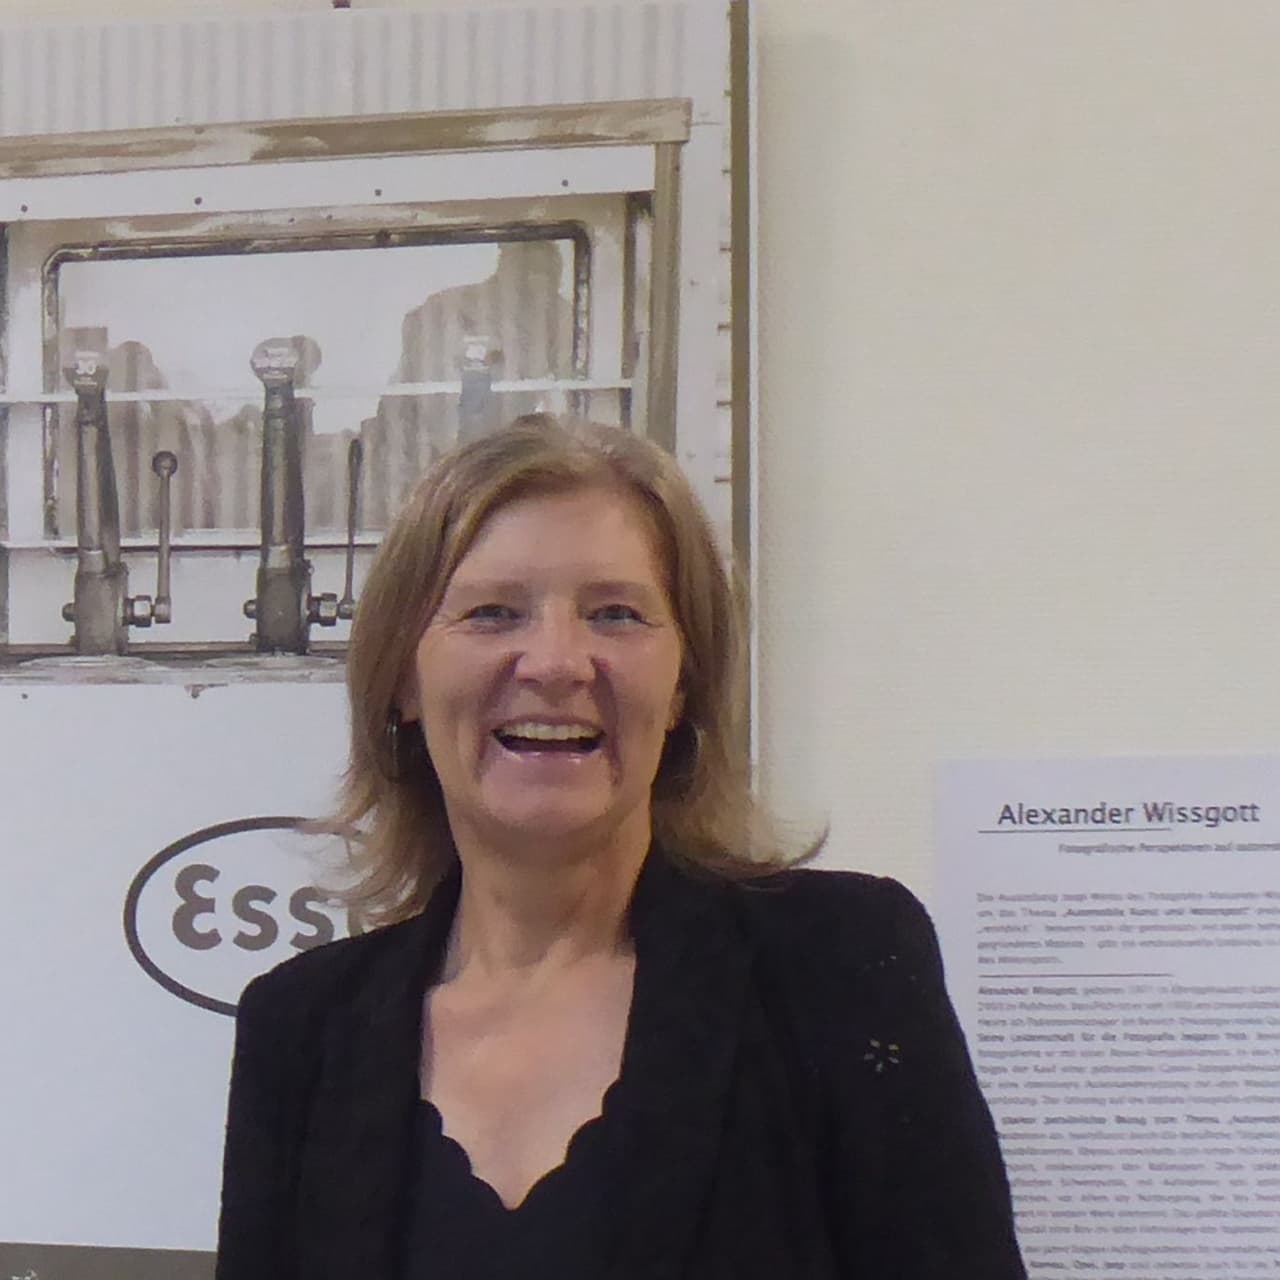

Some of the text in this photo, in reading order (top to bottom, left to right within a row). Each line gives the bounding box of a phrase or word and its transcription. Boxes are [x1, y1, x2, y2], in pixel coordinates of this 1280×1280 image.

[997, 802, 1262, 828] Alexander Wissgott
[172, 863, 366, 951] Ess
